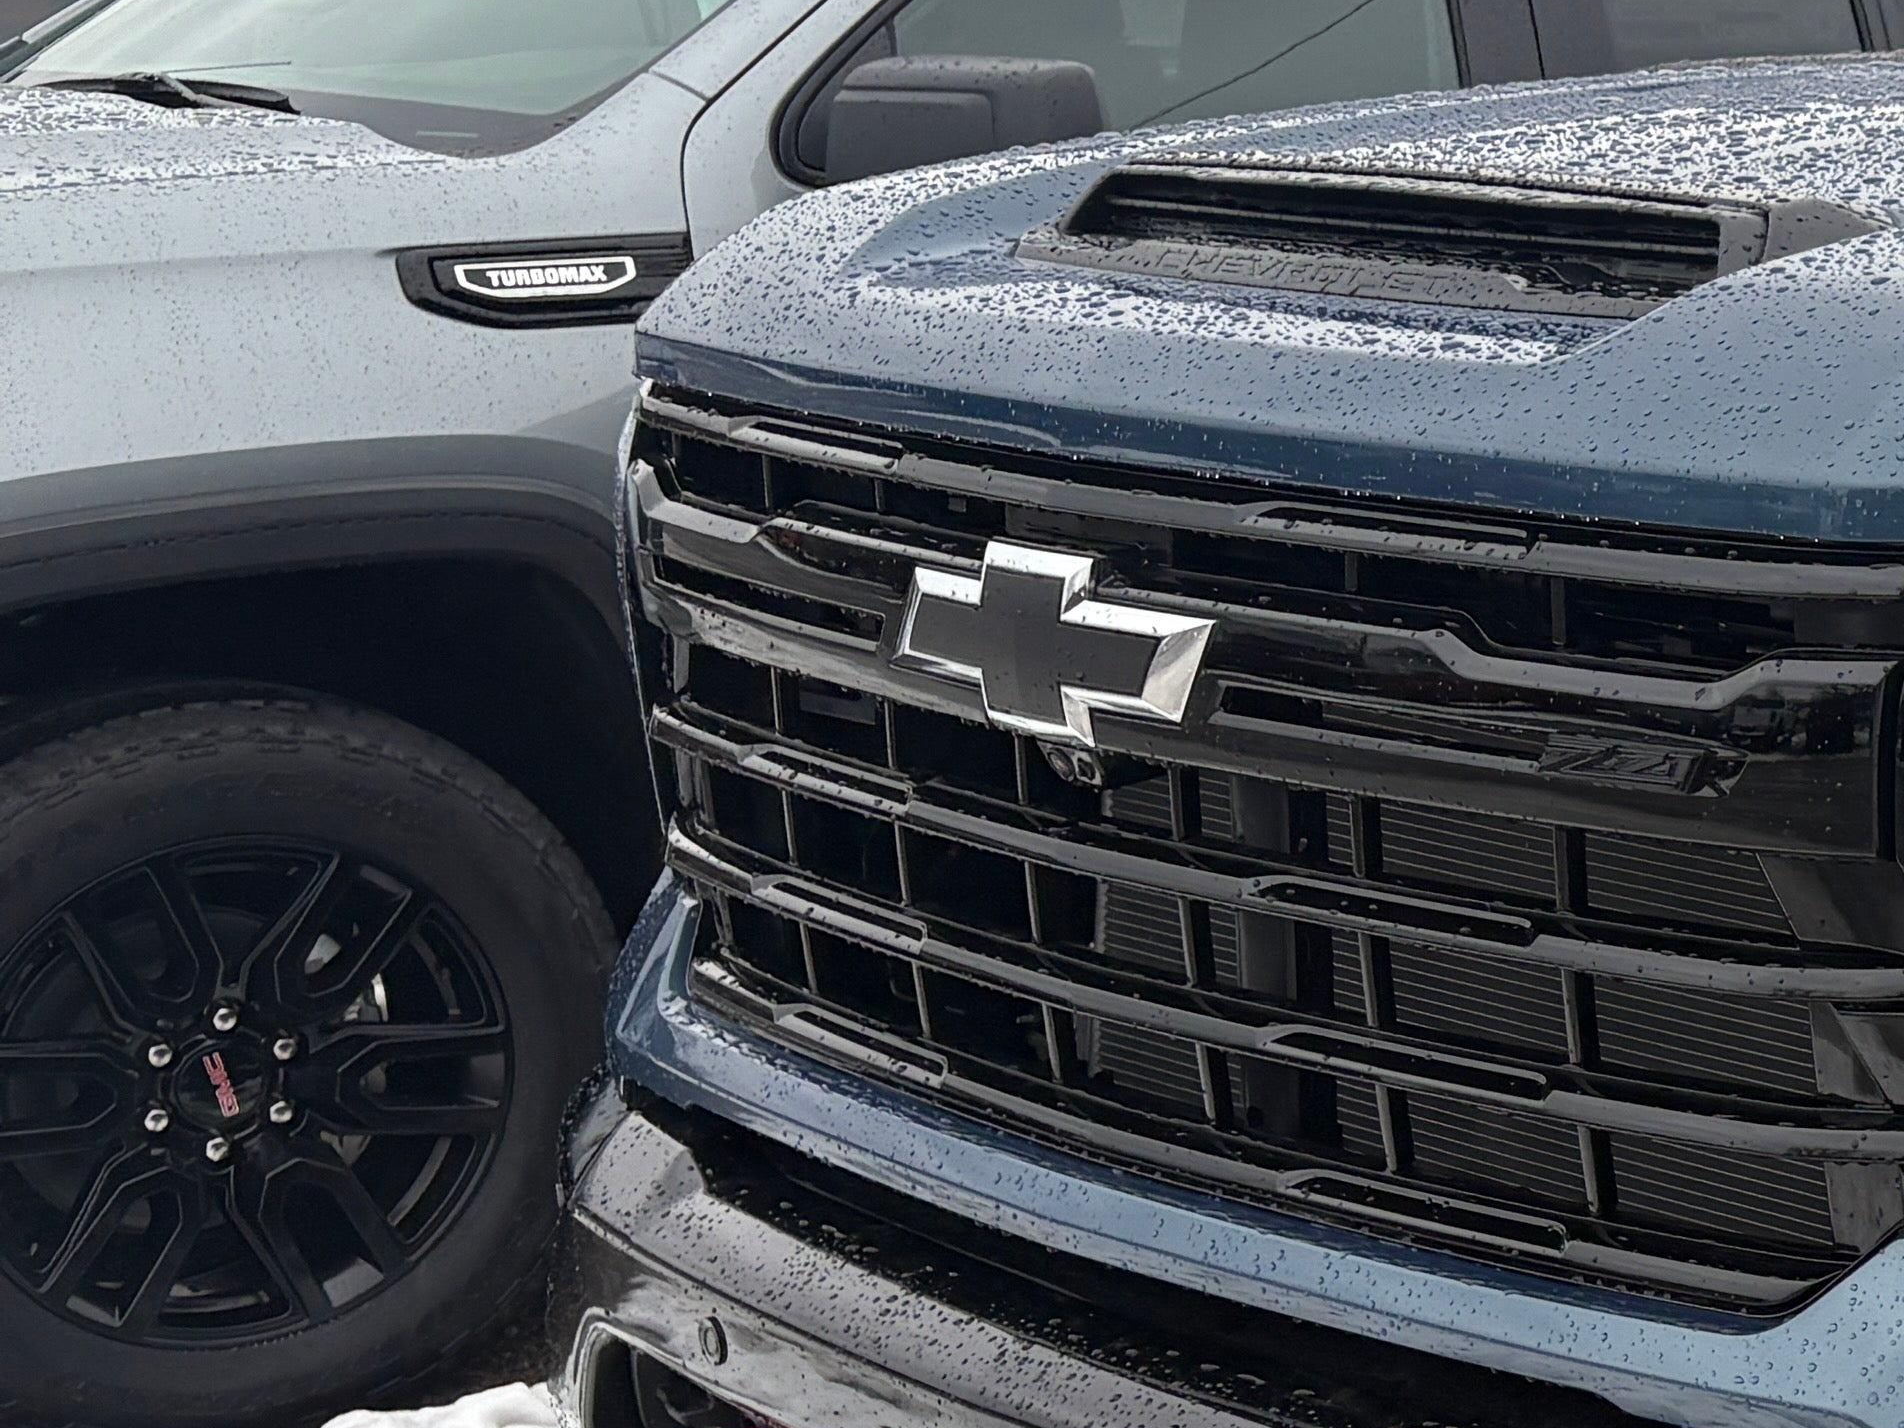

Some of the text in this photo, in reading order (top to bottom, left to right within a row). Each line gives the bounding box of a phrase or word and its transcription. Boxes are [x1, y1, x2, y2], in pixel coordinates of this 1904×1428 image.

[485, 264, 608, 288] TURBOMAX
[1155, 246, 1450, 296] CHEVROLET
[202, 1051, 240, 1118] GMC
